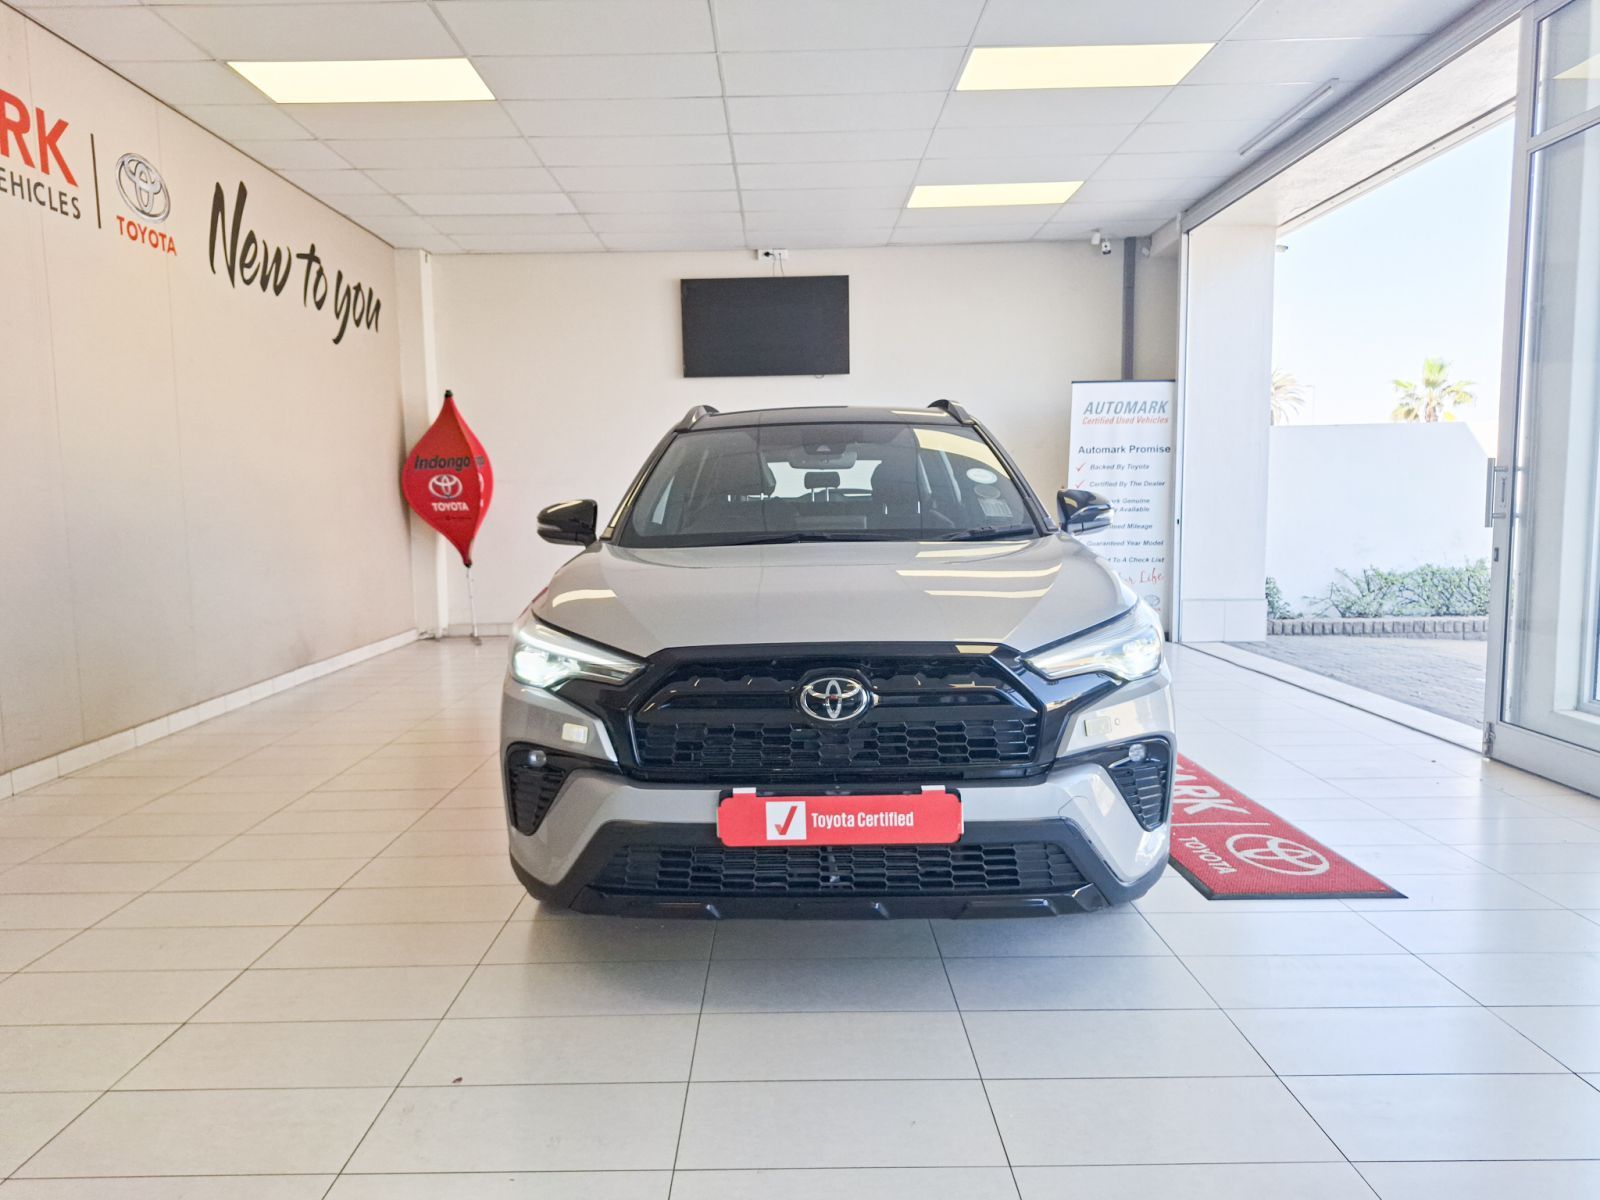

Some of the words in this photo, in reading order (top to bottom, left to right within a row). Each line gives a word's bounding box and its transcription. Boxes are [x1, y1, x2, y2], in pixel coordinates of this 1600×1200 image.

[116, 215, 178, 256] TOYOTA
[208, 180, 292, 297] New
[296, 243, 328, 311] to
[332, 269, 382, 345] you
[1083, 401, 1168, 415] AUTOMARK
[1082, 416, 1114, 425] Certified
[1115, 416, 1134, 424] Used
[1136, 415, 1168, 424] Vehicles
[1078, 445, 1126, 454] Automark
[1129, 444, 1171, 453] Promise
[414, 455, 470, 472] Indongo
[431, 502, 469, 512] TOYOTA
[811, 812, 855, 829] Toyota
[857, 811, 914, 828] Certified
[1178, 837, 1237, 874] TOYOTA
